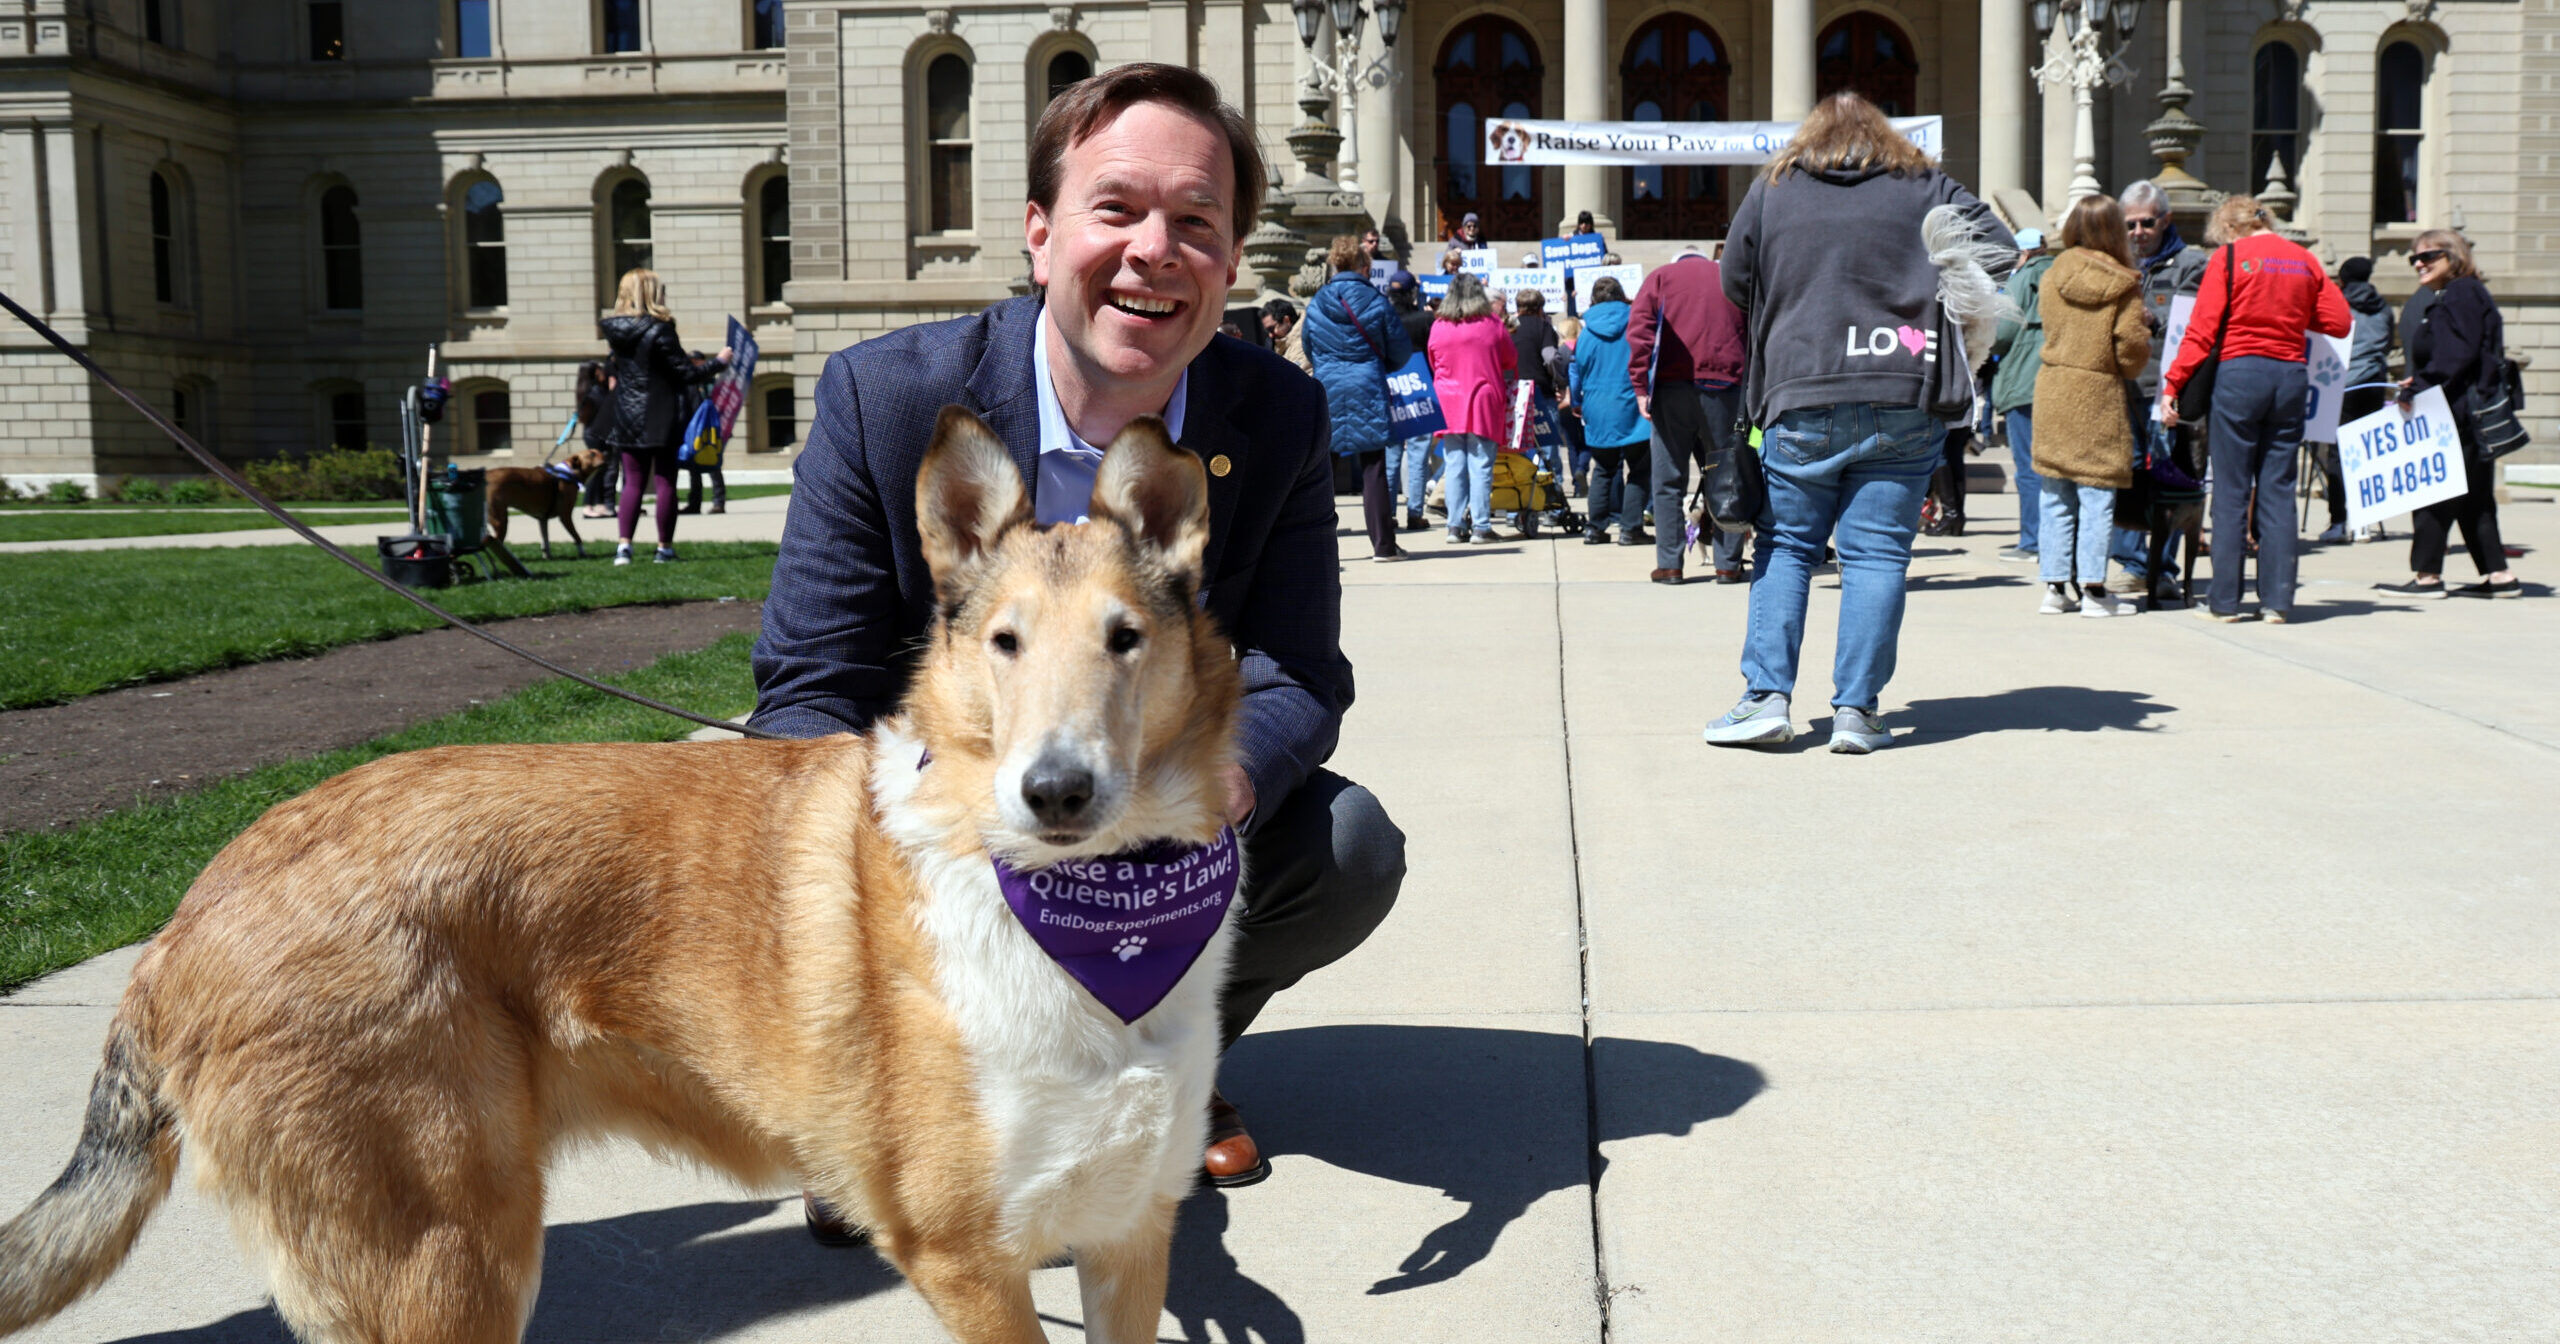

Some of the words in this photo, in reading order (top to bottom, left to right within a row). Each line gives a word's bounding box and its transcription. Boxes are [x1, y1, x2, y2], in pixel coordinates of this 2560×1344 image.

[1536, 132, 1600, 151] Raise
[1606, 133, 1658, 151] Your
[1666, 134, 1717, 151] Paw
[1723, 140, 1745, 151] for
[1471, 257, 1485, 267] on
[1544, 246, 1569, 258] Save
[1571, 242, 1600, 255] Dogs,
[1514, 273, 1547, 285] STOP
[1847, 326, 1938, 362] LOE
[1386, 372, 1428, 396] ogs,
[1389, 396, 1435, 423] ients!
[2361, 422, 2398, 460] YES
[2403, 415, 2430, 446] on
[2359, 474, 2386, 508] HB
[2392, 452, 2447, 496] 4849
[1030, 871, 1178, 911] Queenie's
[1183, 848, 1233, 893] Law!
[1052, 860, 1107, 882] aise
[1117, 861, 1135, 881] a
[1039, 890, 1223, 933] EndDogExperiments.org
